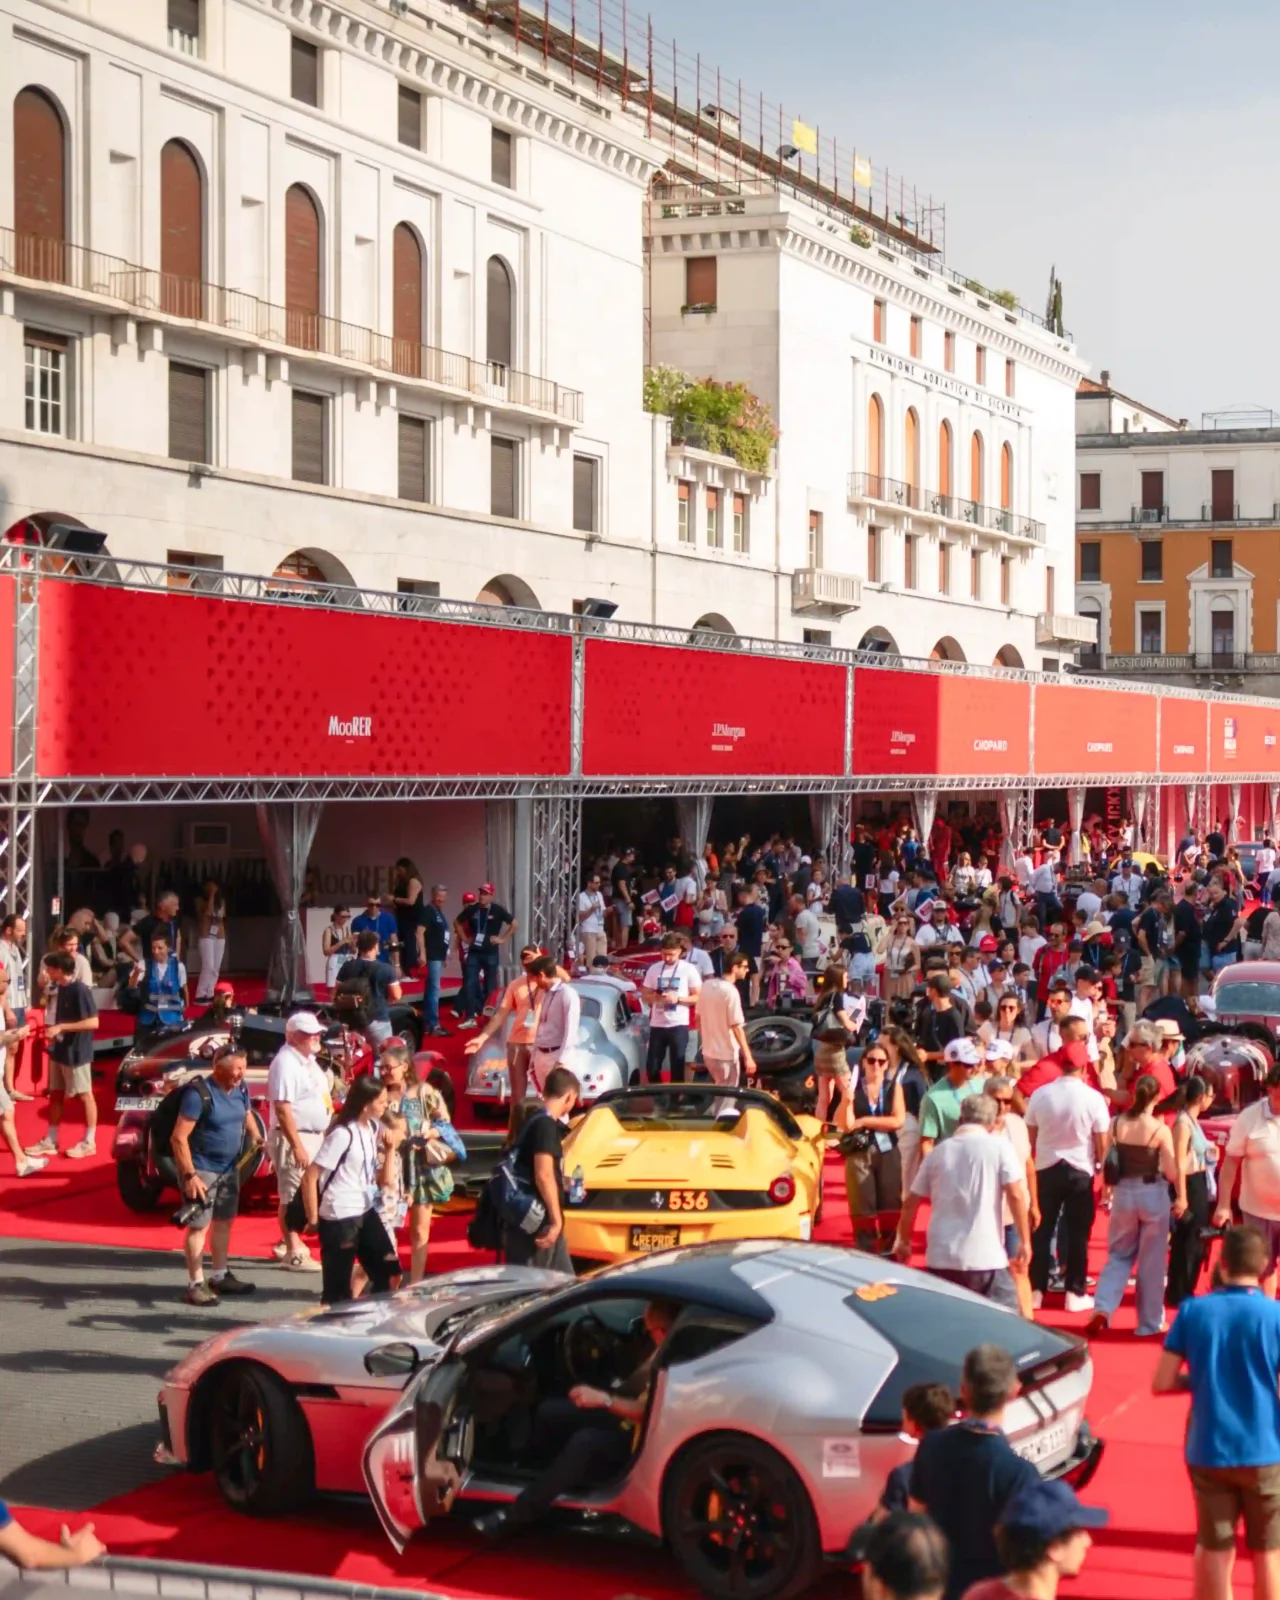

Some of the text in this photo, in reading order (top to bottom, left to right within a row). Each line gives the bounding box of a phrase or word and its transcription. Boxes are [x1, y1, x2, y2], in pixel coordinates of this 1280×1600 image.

[923, 371, 969, 398] ADRIATICA
[1113, 656, 1186, 668] ASSICURAZIONI
[328, 715, 372, 737] MooRER
[973, 739, 1009, 752] CHOPARD
[668, 1190, 709, 1211] 536
